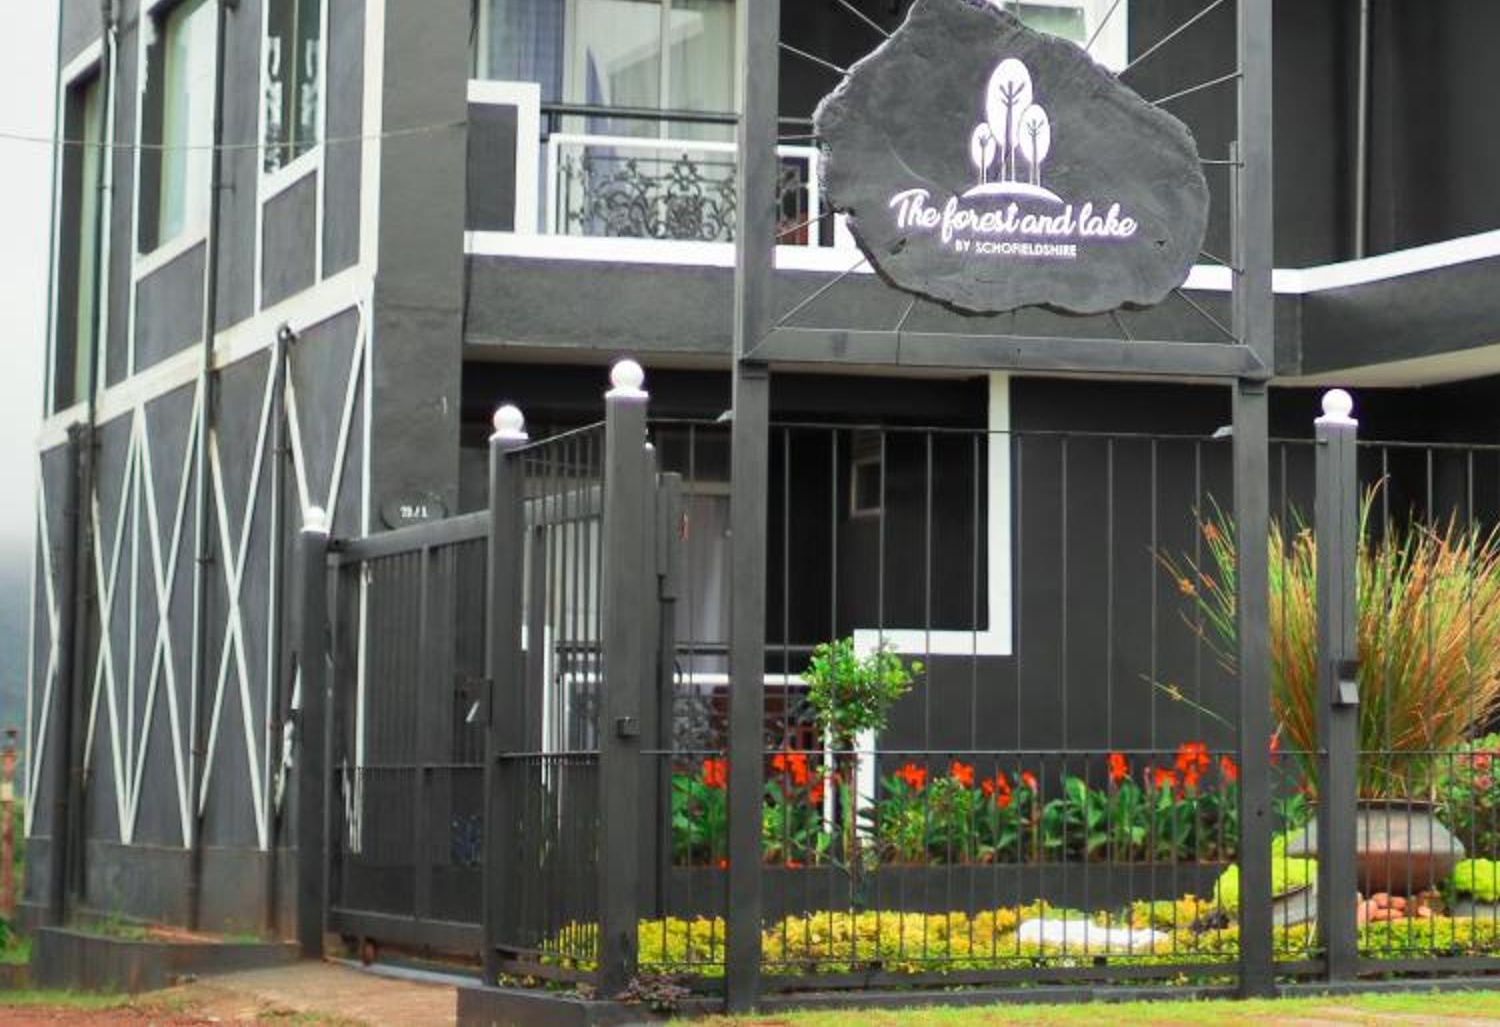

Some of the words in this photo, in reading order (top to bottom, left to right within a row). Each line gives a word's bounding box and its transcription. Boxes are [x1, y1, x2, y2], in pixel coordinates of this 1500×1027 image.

[889, 188, 940, 228] The
[941, 196, 1019, 243] forest
[1020, 204, 1076, 234] and
[1079, 202, 1137, 237] lake
[955, 239, 970, 252] BY
